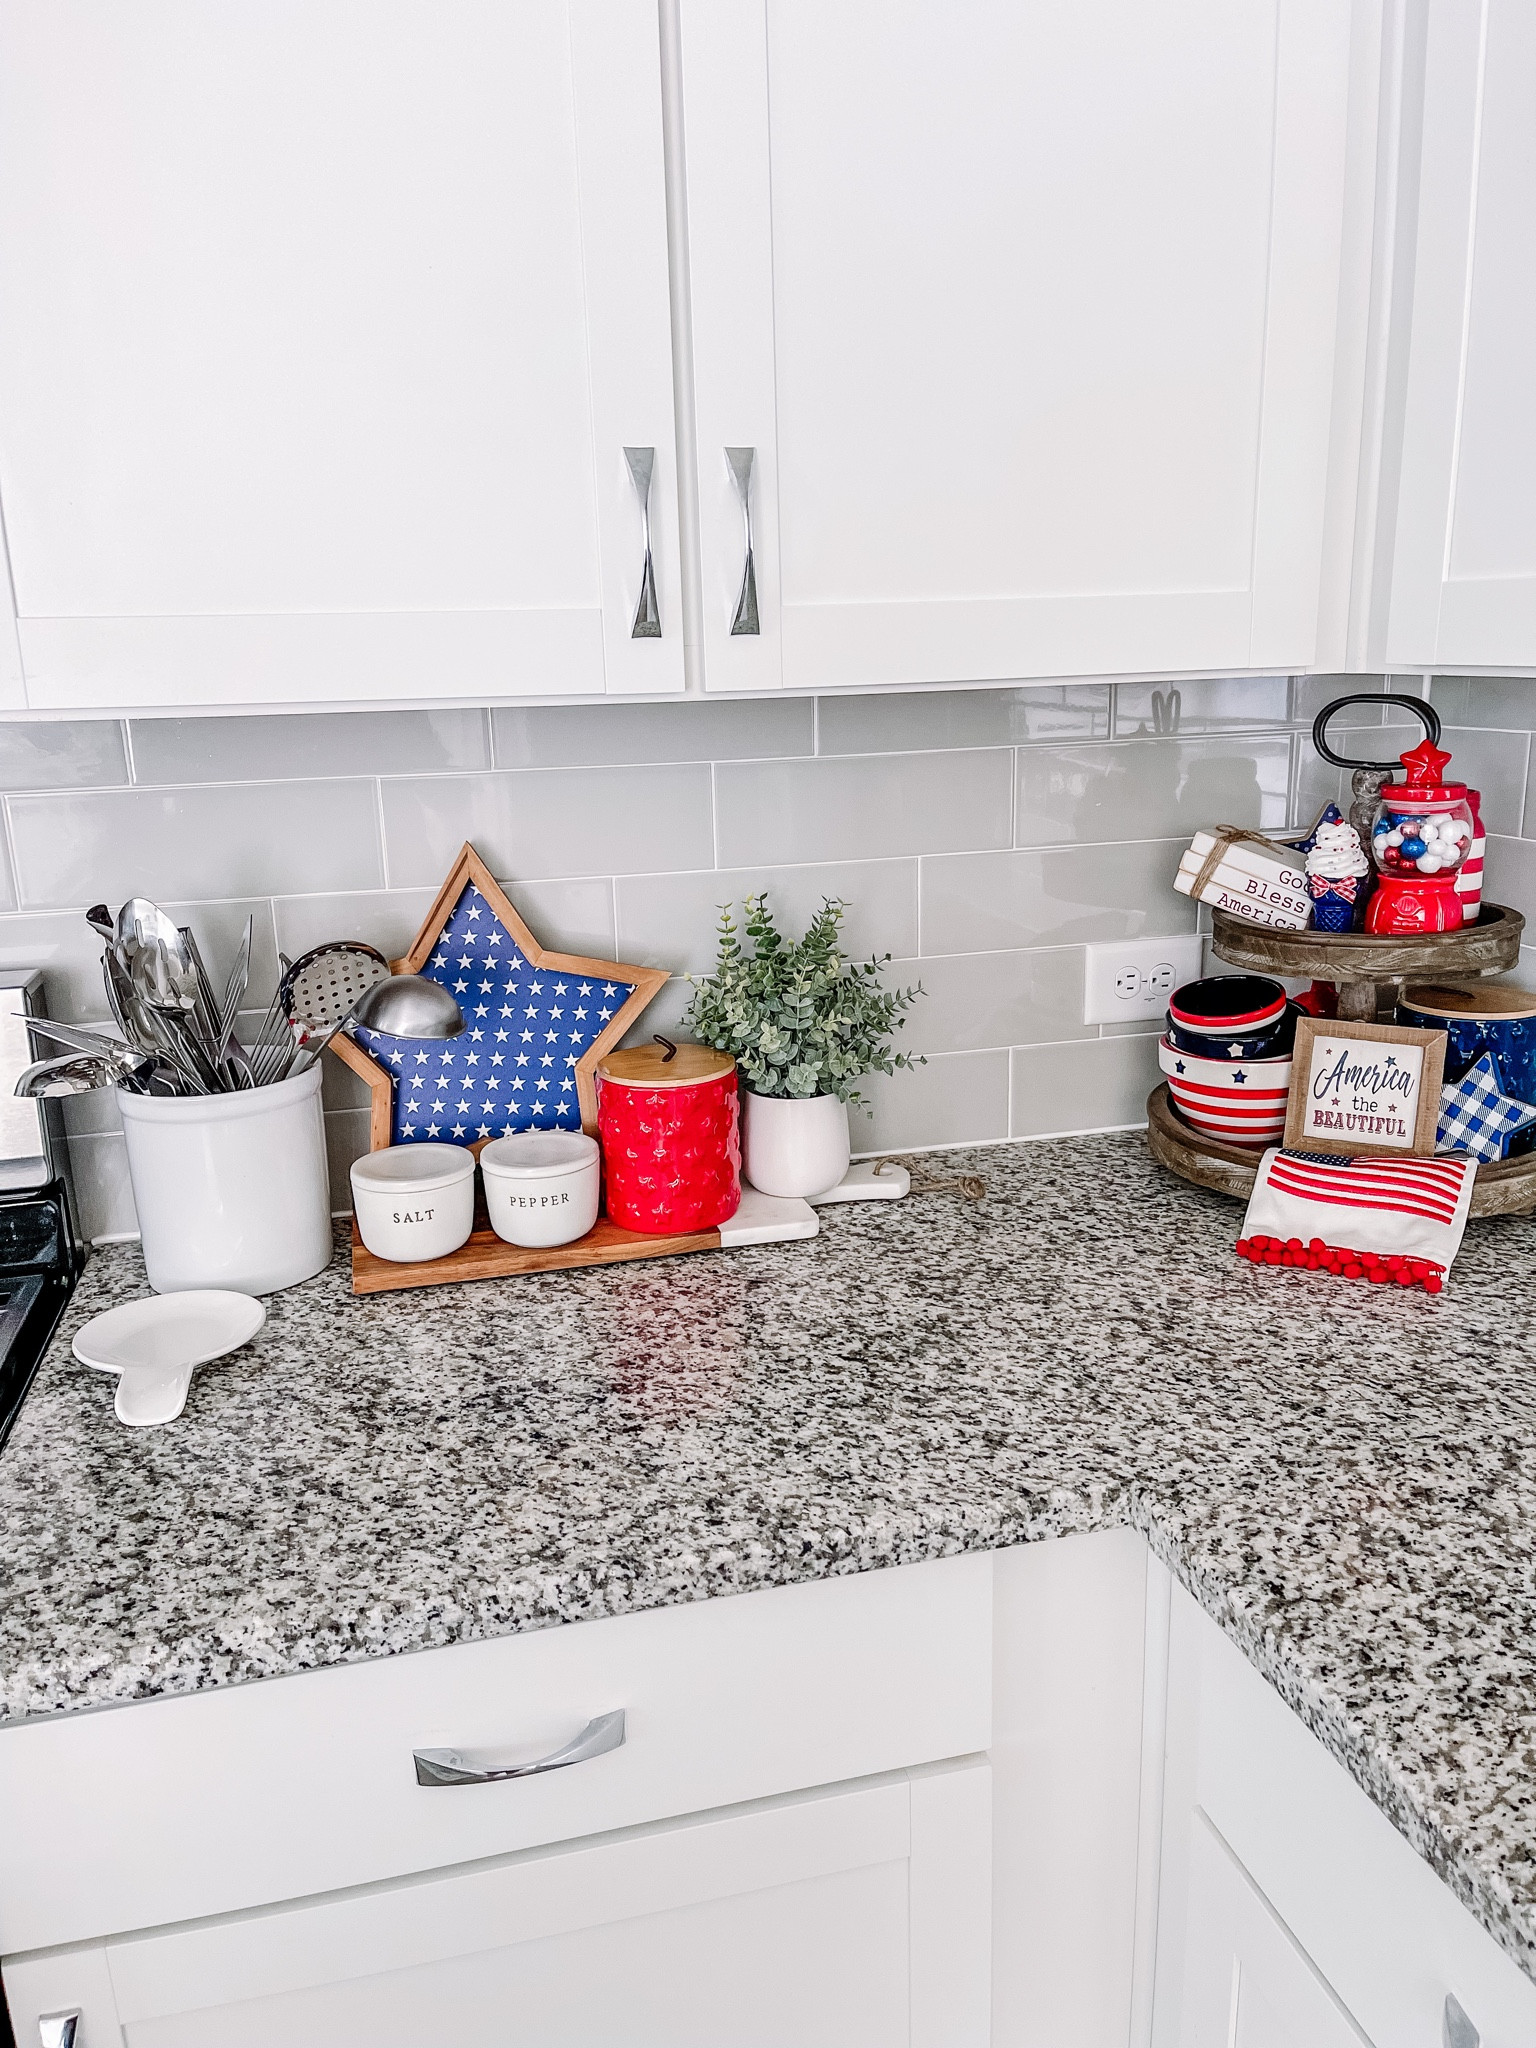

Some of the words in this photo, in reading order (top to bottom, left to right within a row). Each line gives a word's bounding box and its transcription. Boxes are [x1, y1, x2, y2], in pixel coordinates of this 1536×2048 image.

[1245, 879, 1306, 913] Bless
[1217, 892, 1297, 930] America
[1313, 1050, 1416, 1100] America
[1352, 1095, 1378, 1112] the
[1312, 1109, 1406, 1137] BEAUTIFUL
[510, 1192, 570, 1208] PEPPER
[393, 1208, 435, 1224] SALT
